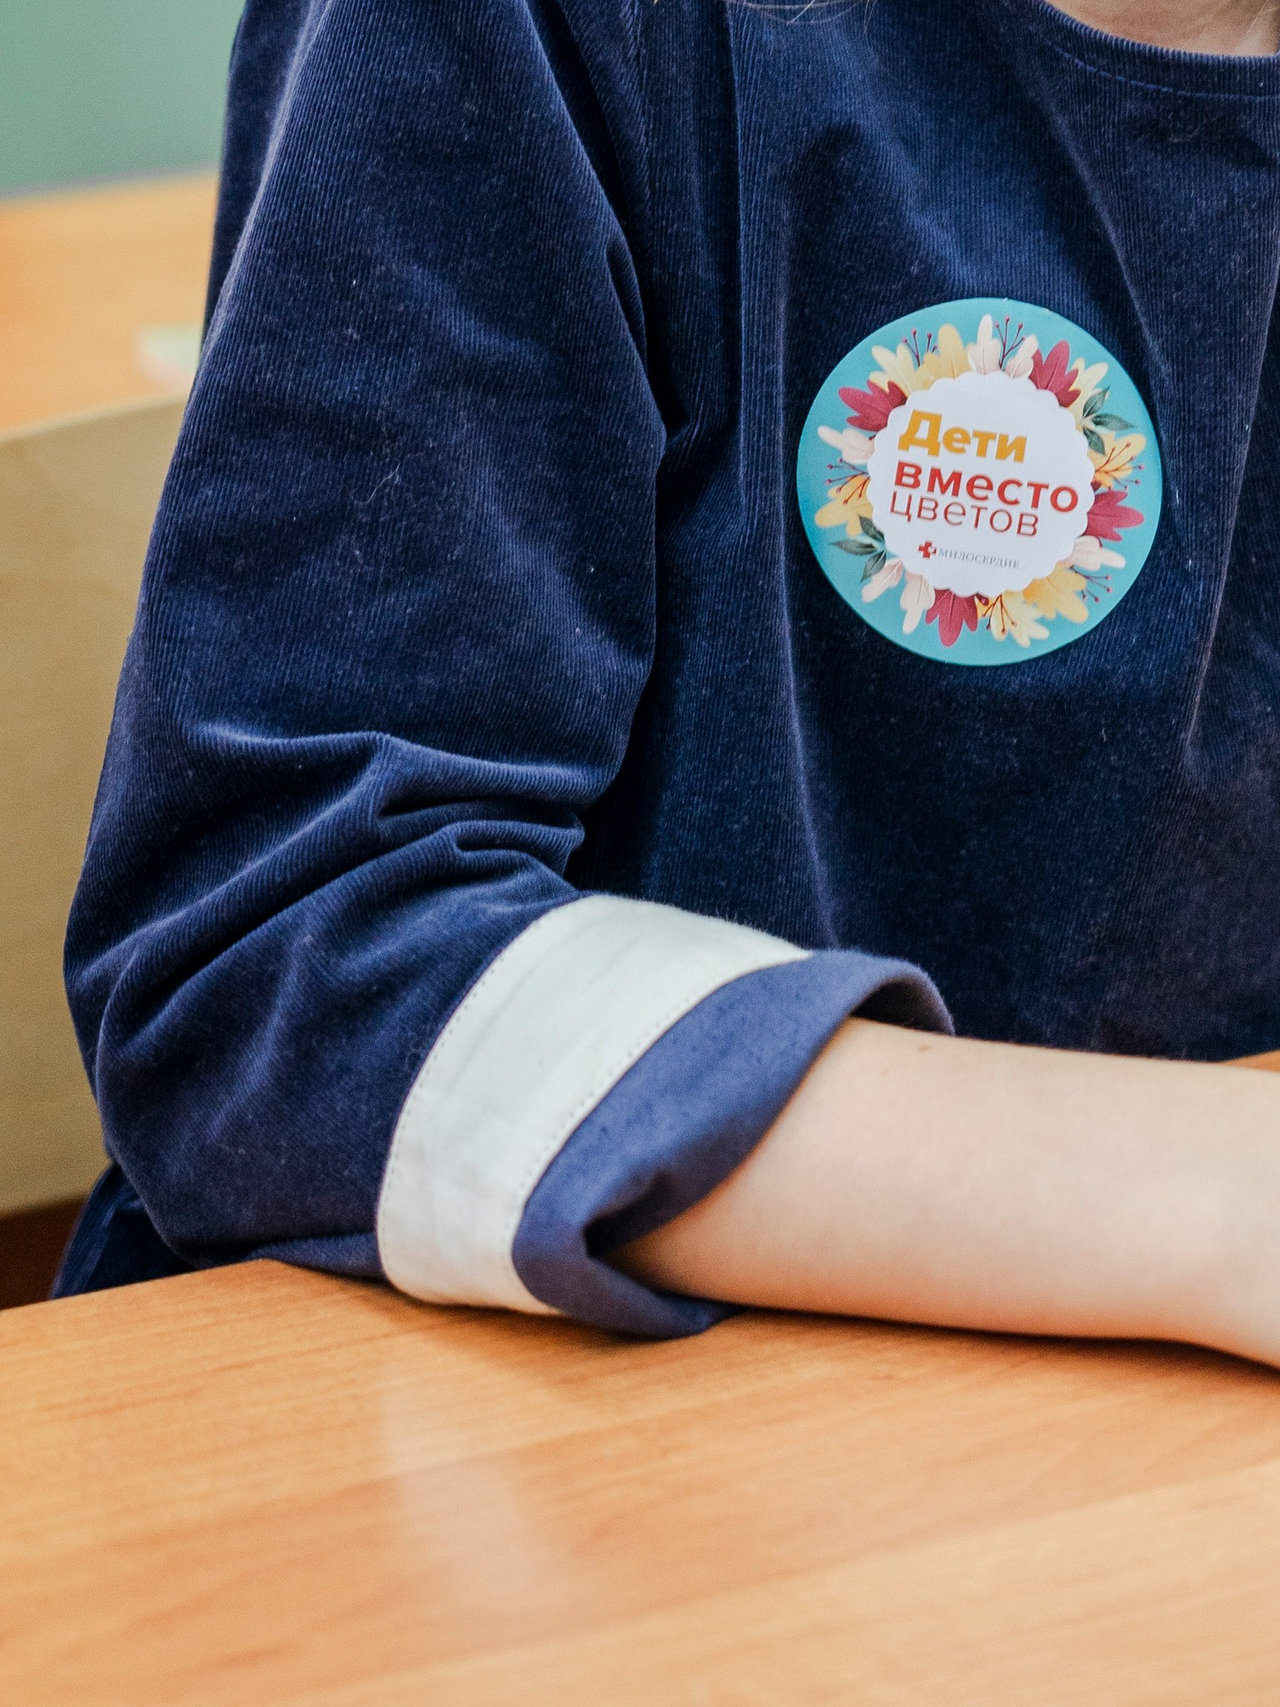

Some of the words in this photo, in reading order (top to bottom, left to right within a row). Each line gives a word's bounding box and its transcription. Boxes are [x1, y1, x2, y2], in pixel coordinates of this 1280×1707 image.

[898, 409, 1028, 463] Дети
[894, 460, 1079, 512] вместо
[890, 490, 1039, 536] цветов
[939, 548, 1020, 569] МИЛОСЕРДИЕ
